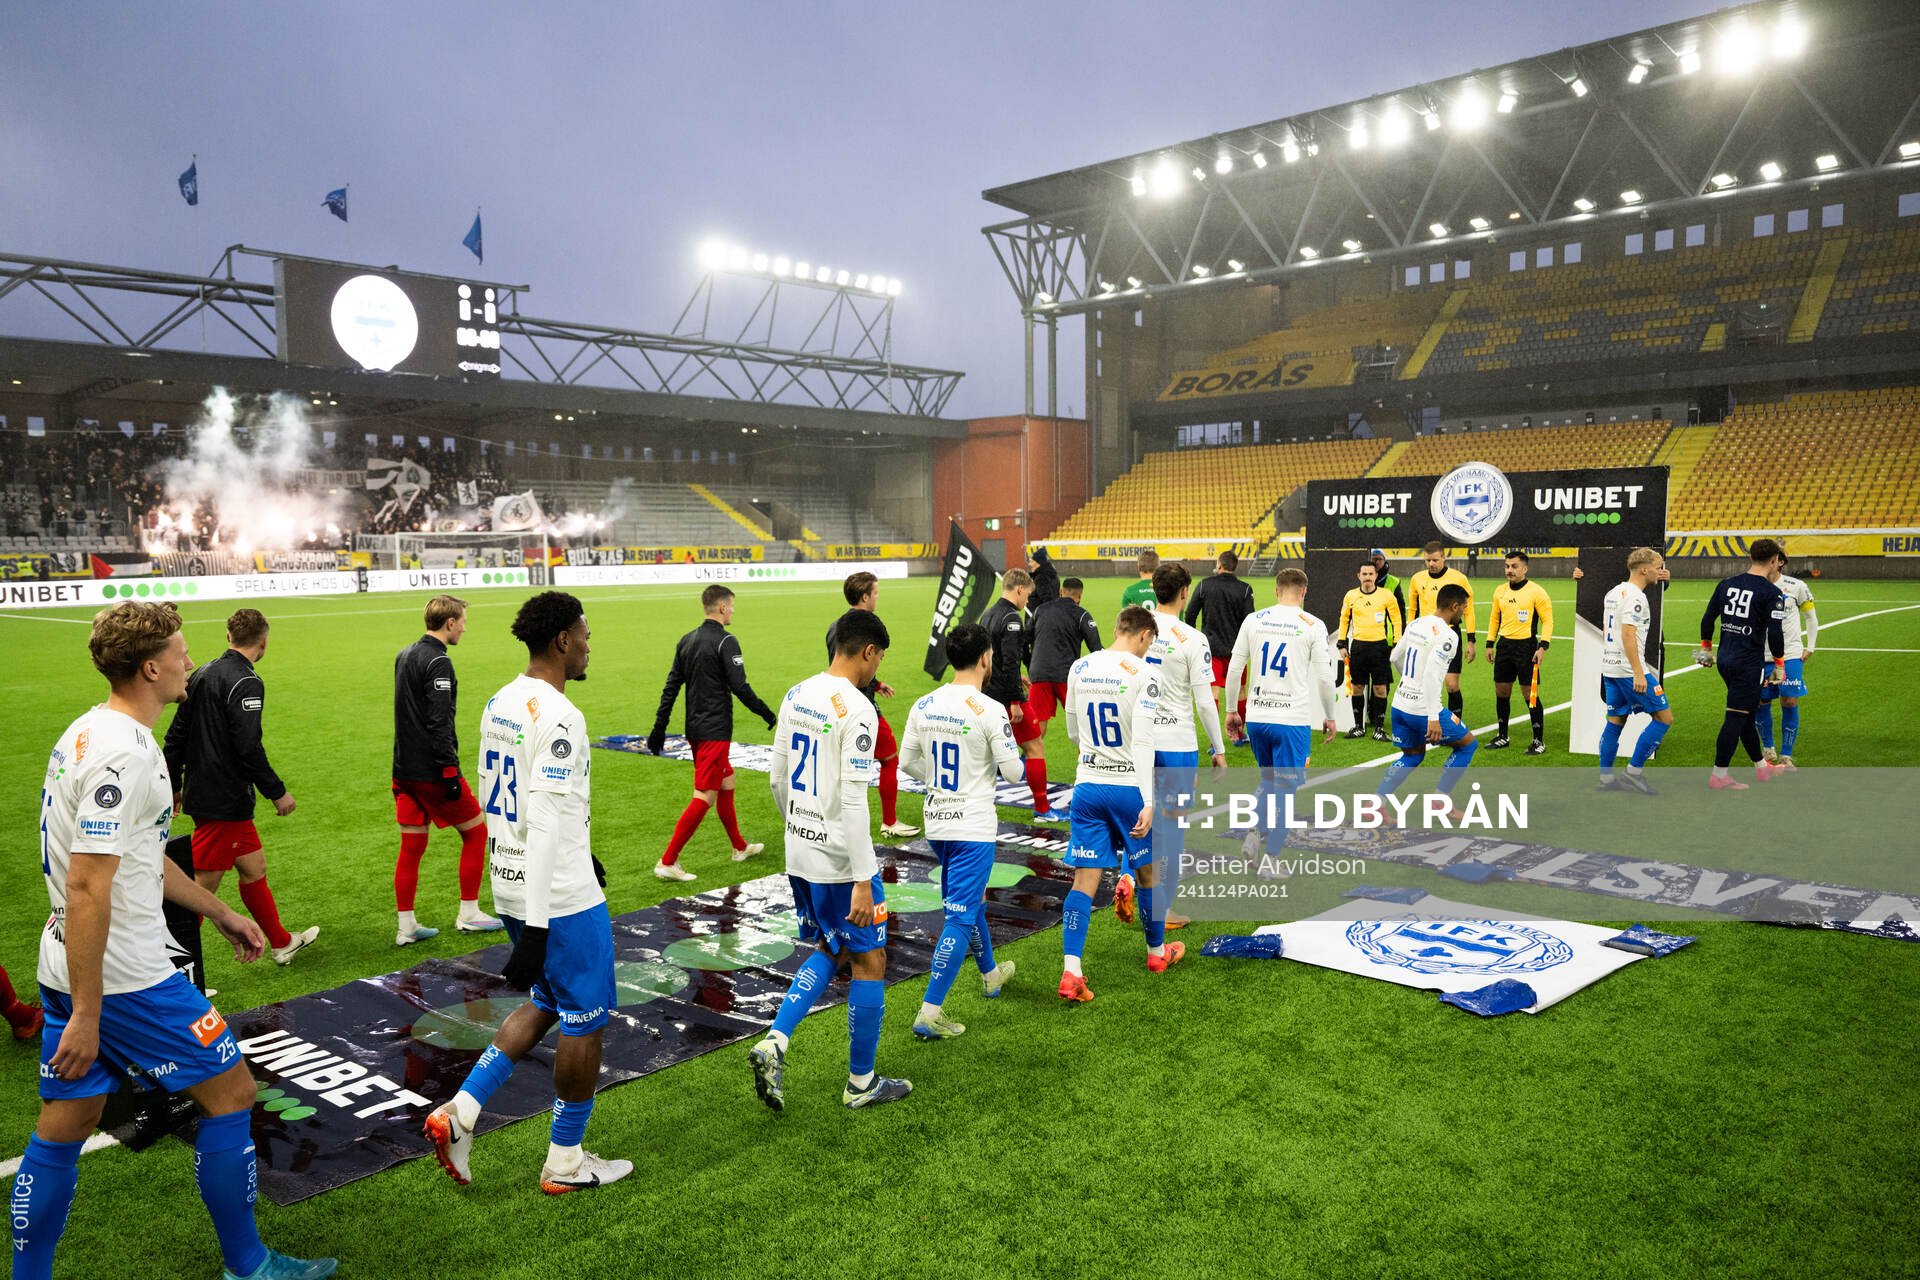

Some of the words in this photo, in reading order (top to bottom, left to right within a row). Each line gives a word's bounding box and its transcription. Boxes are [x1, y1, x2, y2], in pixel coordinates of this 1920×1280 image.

[1170, 360, 1313, 396] BORÅS
[1458, 483, 1483, 495] IFK
[1534, 485, 1643, 511] UNIBET
[1323, 493, 1412, 516] UNIBET
[1097, 547, 1117, 557] HEJA
[409, 573, 469, 587] UNIBET
[695, 567, 739, 579] UNIBET
[235, 579, 276, 592] SPELA
[281, 579, 308, 591] LIVE
[1724, 586, 1754, 619] 39
[1261, 641, 1288, 678] 14
[1405, 646, 1417, 679] 11
[1086, 702, 1123, 747] 16
[541, 765, 572, 777] UNIBET
[791, 731, 819, 797] 21
[850, 757, 872, 766] UNIBET
[931, 739, 960, 793] 19
[486, 749, 517, 823] 23
[80, 819, 121, 831] UNIBET
[1428, 923, 1517, 945] IFK
[934, 937, 956, 969] office
[788, 992, 802, 1004] 4
[566, 1006, 604, 1025] RAVEMA
[216, 1036, 237, 1064] 25
[236, 1029, 432, 1119] UNIBET
[10, 1172, 34, 1230] office
[12, 1236, 29, 1251] 4
